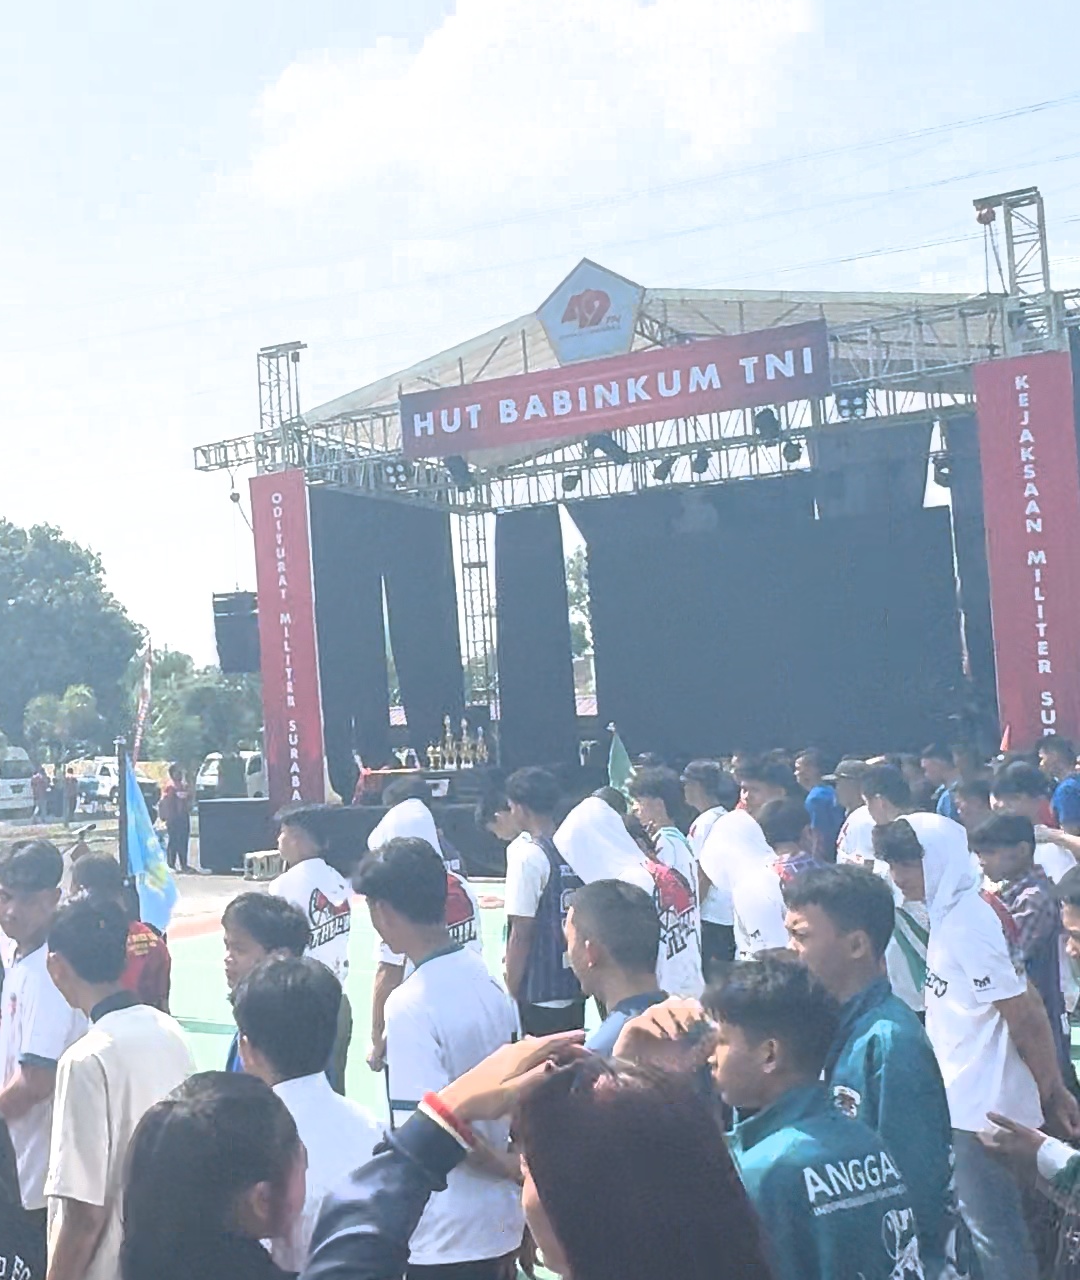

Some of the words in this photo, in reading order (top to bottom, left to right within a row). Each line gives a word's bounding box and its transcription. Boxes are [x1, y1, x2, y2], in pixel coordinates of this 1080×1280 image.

[413, 404, 482, 438] HUT
[498, 363, 722, 424] BABINKUM
[738, 347, 813, 385] TNI
[1014, 374, 1043, 533] KEJAKSAAN
[1027, 550, 1052, 674] MILITER
[802, 1151, 903, 1203] ANGGA
